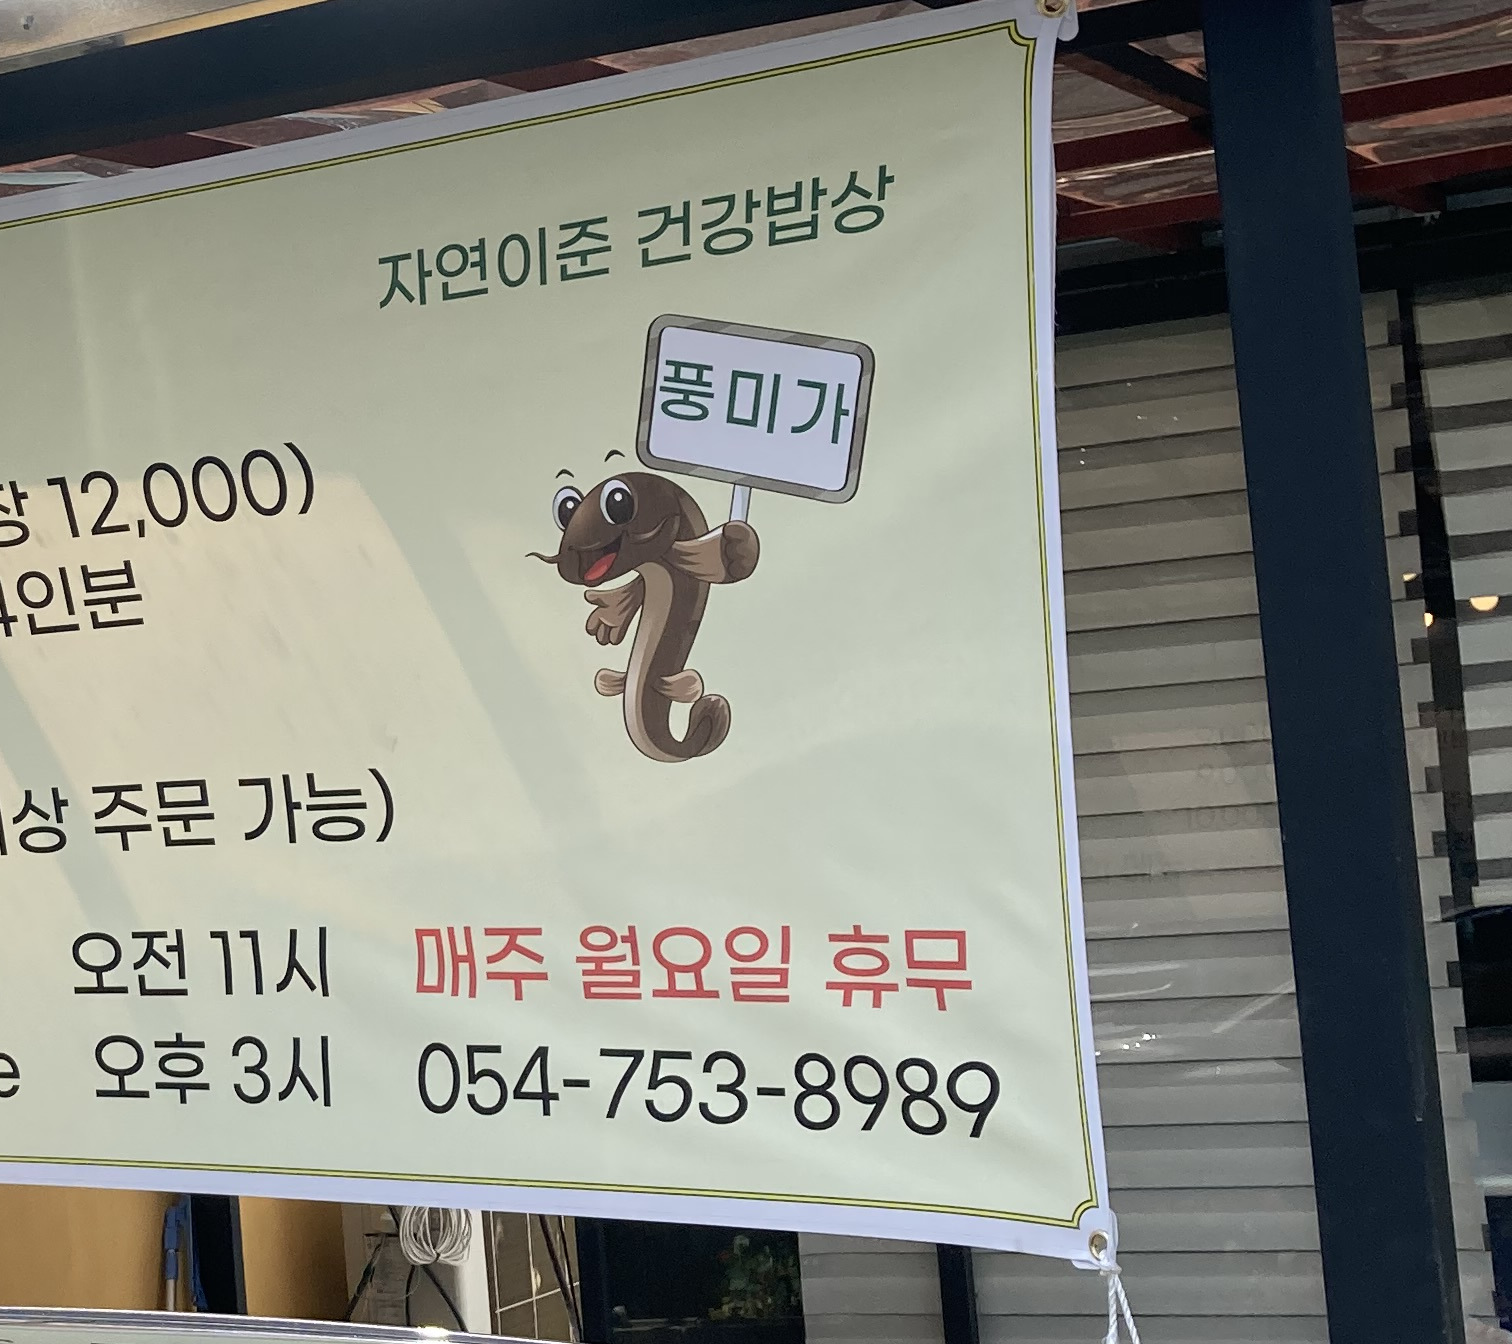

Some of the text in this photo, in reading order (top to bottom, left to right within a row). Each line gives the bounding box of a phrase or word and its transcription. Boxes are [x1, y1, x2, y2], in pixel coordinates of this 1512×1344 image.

[637, 164, 895, 269] 건강밥상
[658, 359, 850, 445] 풍미가
[45, 441, 315, 539] 12,000)
[91, 778, 216, 852] 주문
[237, 767, 394, 844] 가능)
[71, 926, 330, 998] 오전 11시
[414, 924, 973, 1012] 매주 월요일 휴무
[94, 1031, 332, 1108] 오후 3시
[417, 1042, 1001, 1139] 054-753-8989
